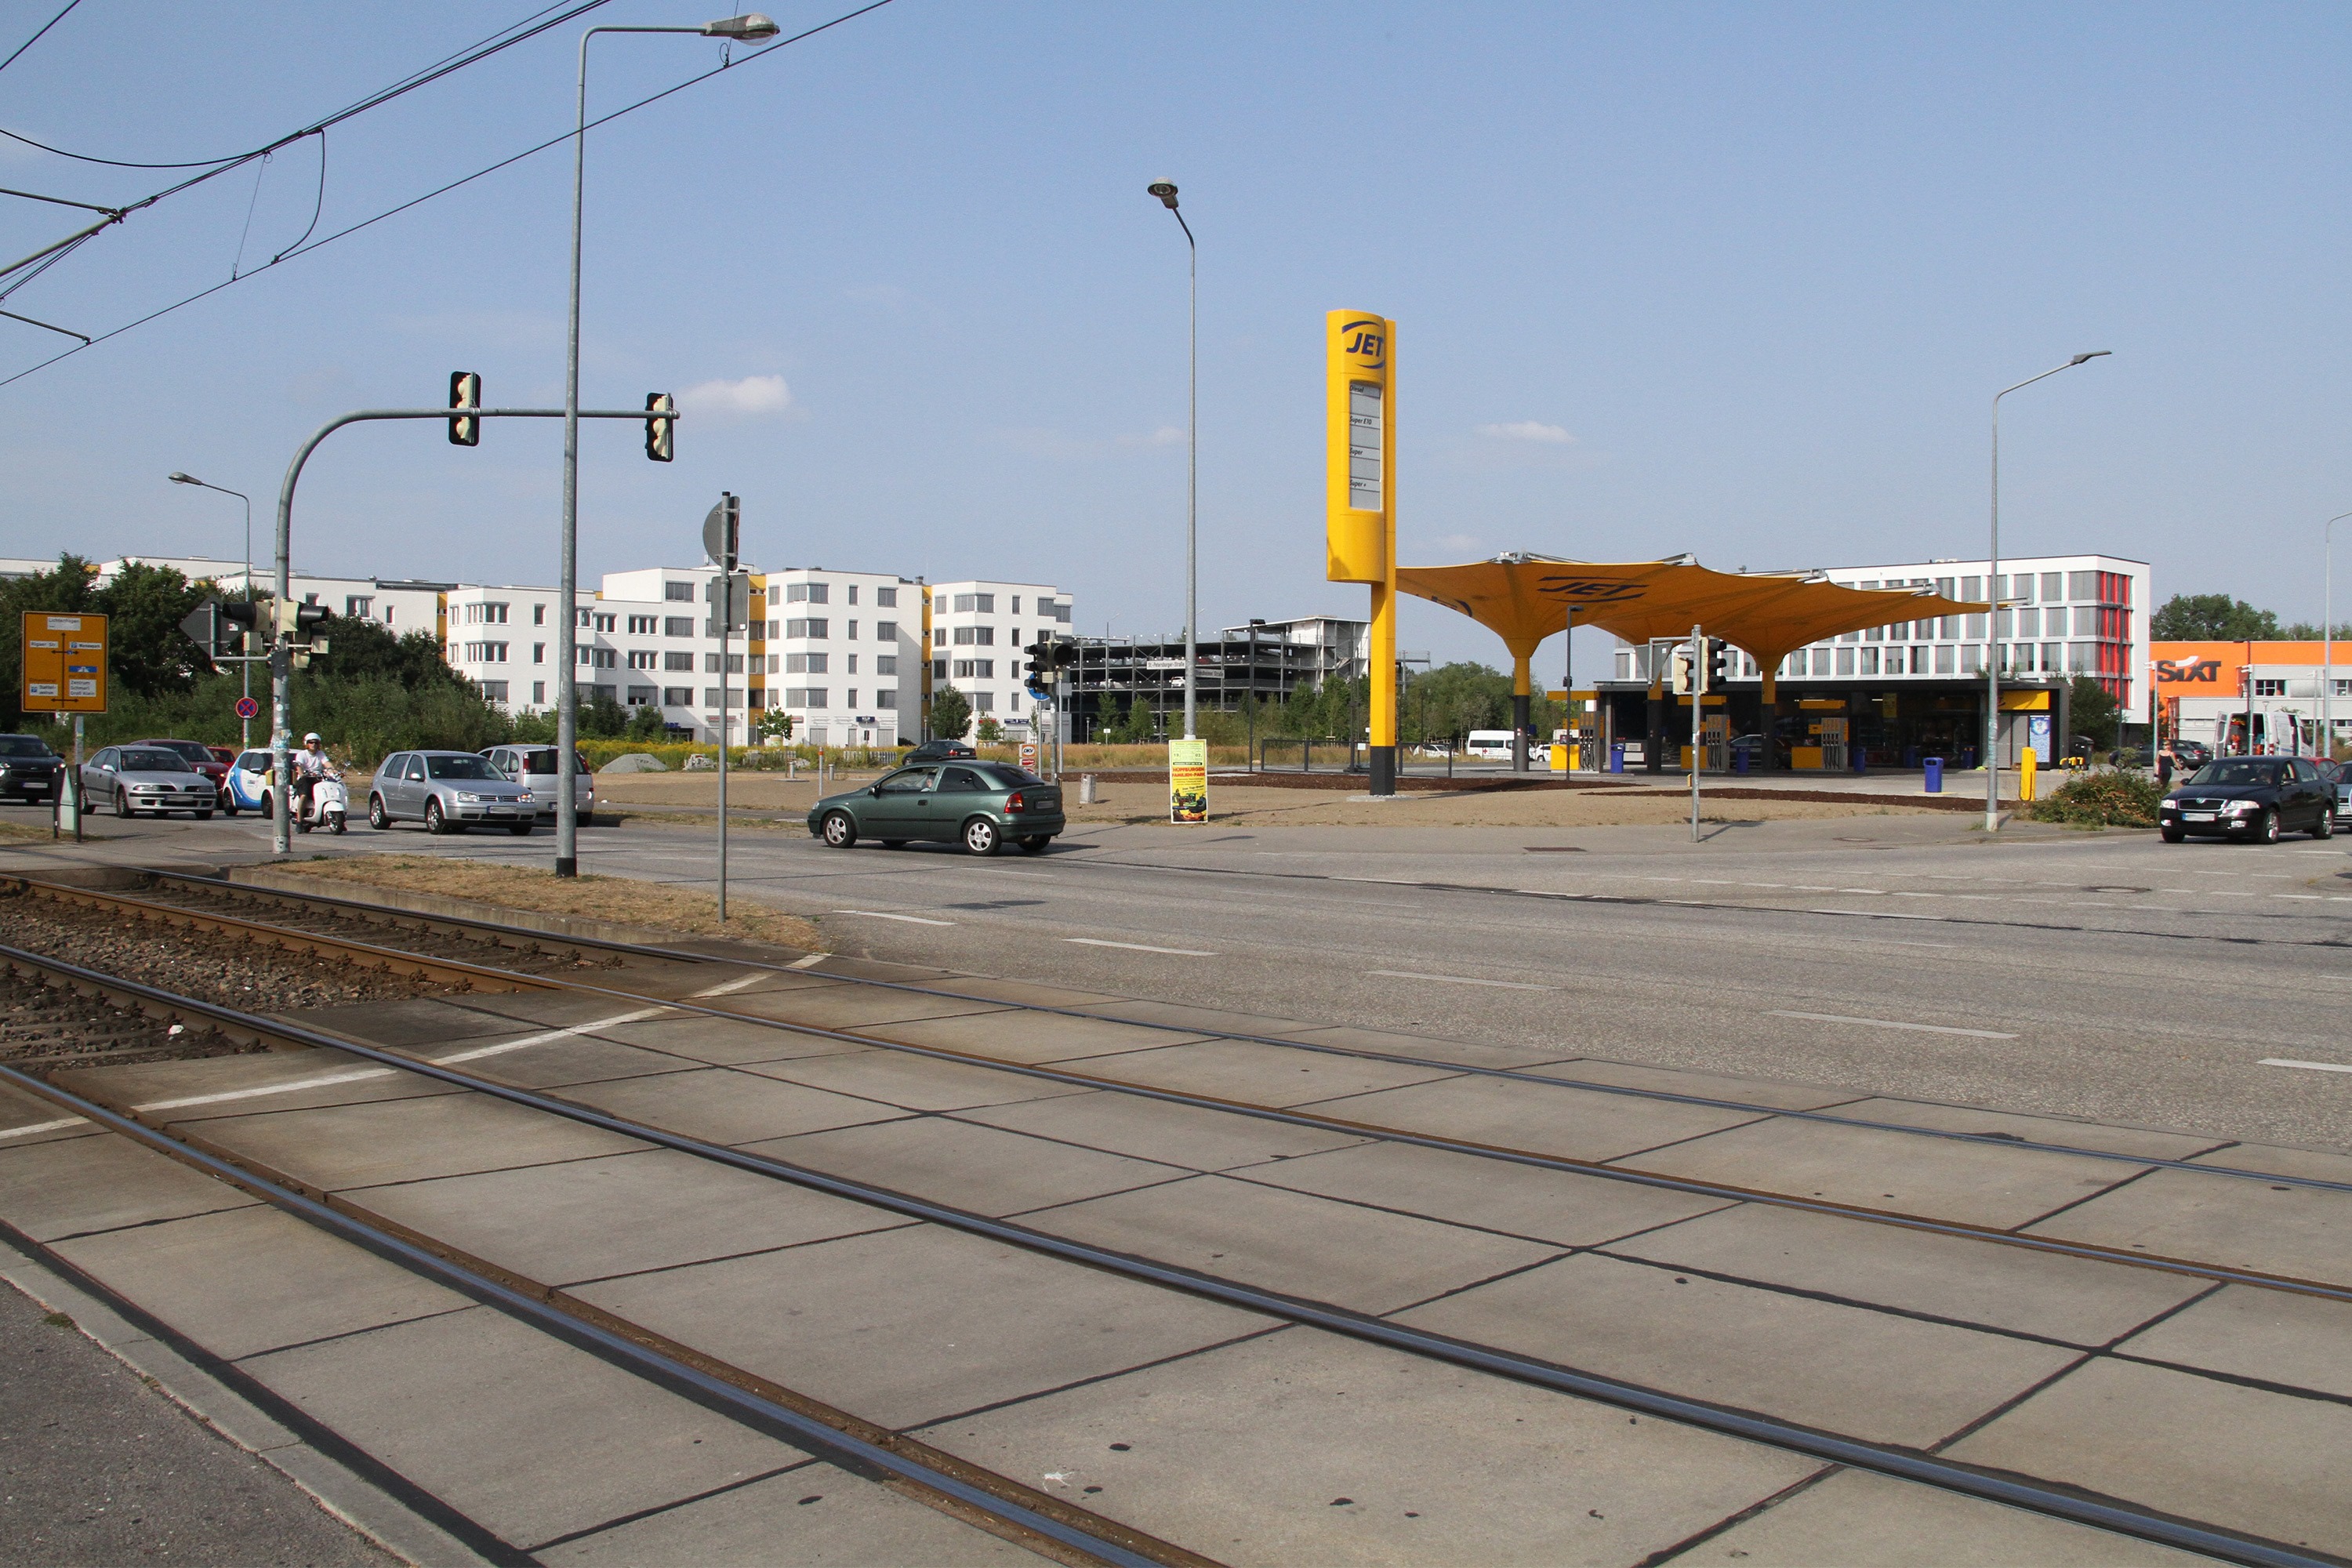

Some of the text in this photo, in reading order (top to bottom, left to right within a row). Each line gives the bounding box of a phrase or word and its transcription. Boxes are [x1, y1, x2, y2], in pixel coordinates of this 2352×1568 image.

[1345, 332, 1384, 358] JET
[1349, 416, 1363, 424] Super
[1349, 479, 1363, 488] Super
[1537, 582, 1650, 596] JET
[2157, 656, 2222, 682] SIXT
